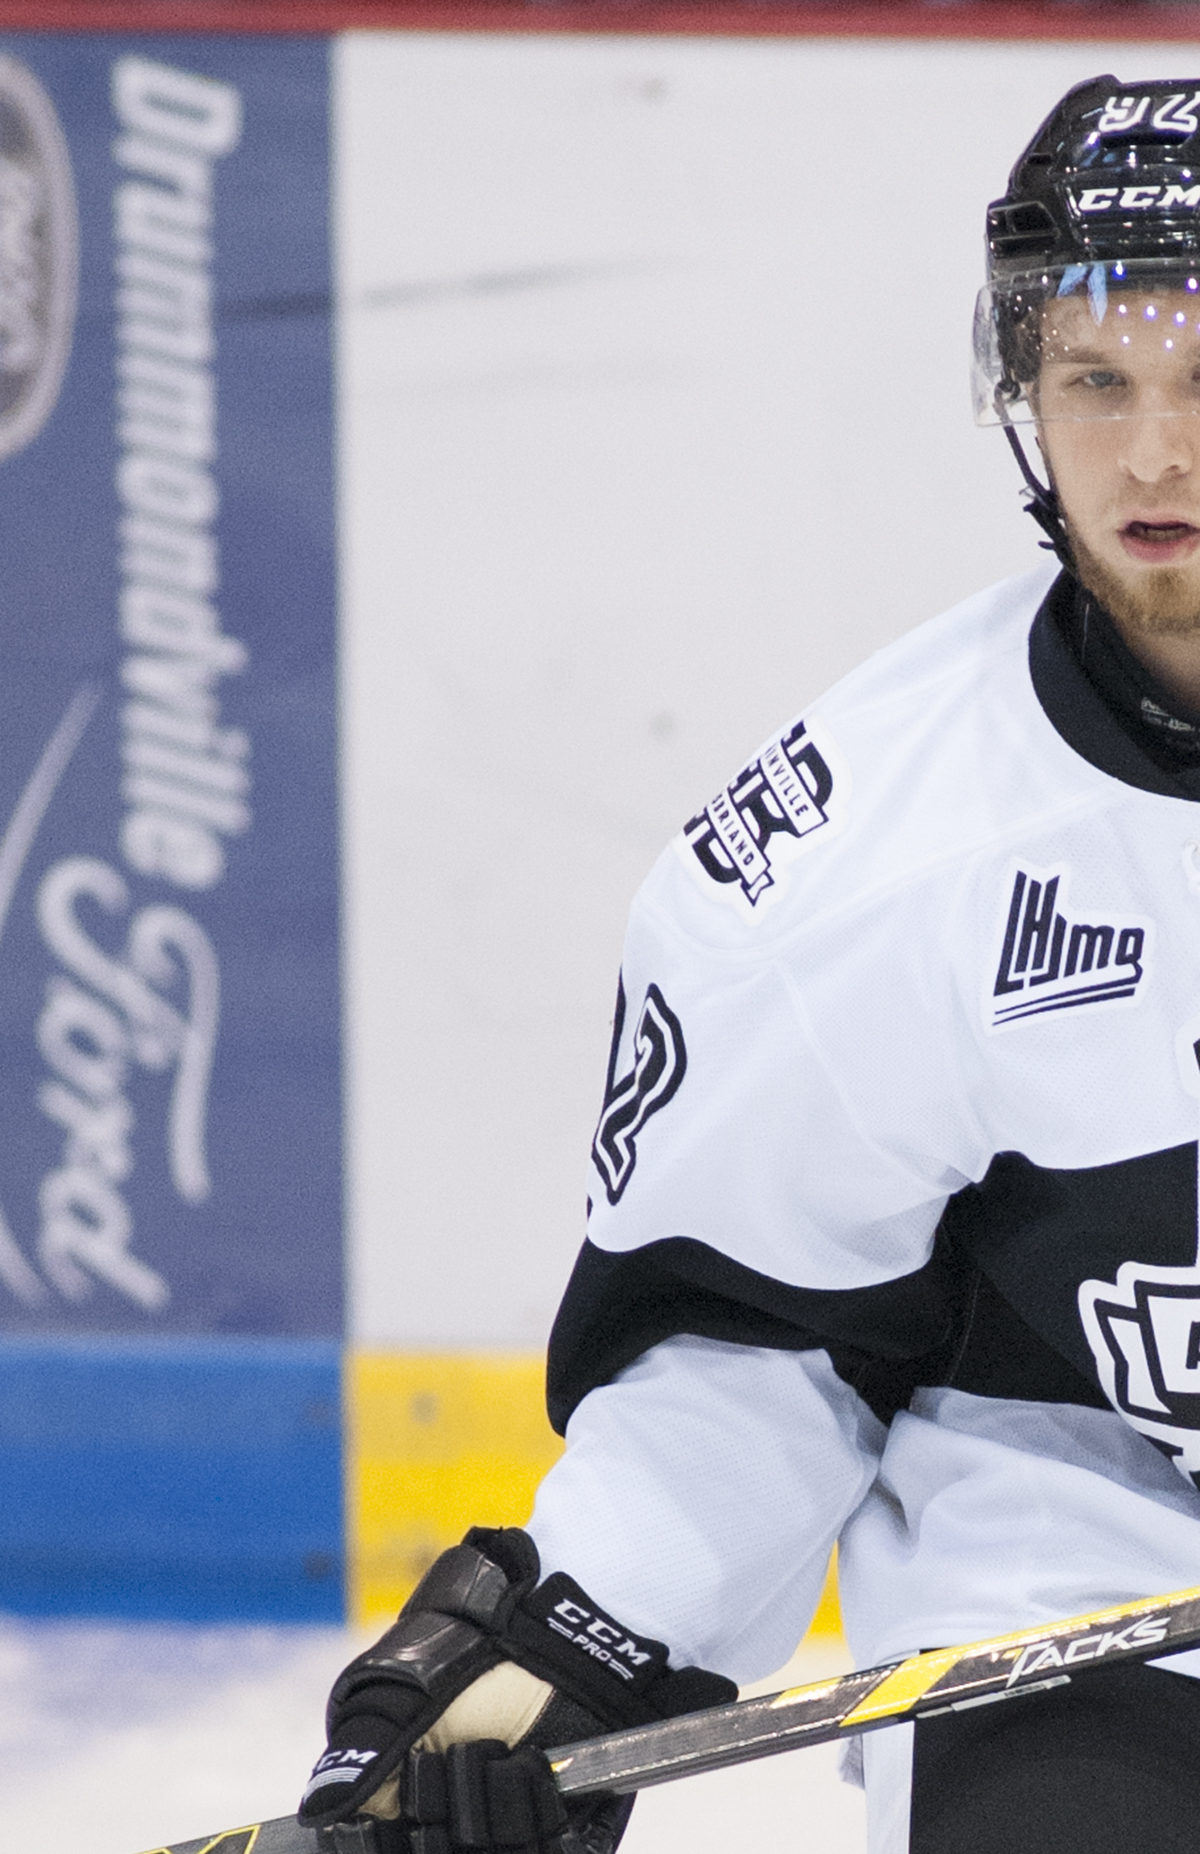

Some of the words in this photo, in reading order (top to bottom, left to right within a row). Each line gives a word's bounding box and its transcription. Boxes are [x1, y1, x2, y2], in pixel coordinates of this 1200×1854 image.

[113, 56, 250, 889] Drummondville
[36, 854, 220, 1306] Ford
[588, 962, 687, 1207] 2
[553, 1598, 652, 1667] CCM
[571, 1634, 612, 1662] PRO
[1006, 1615, 1171, 1688] TACKS
[315, 1749, 379, 1772] CM
